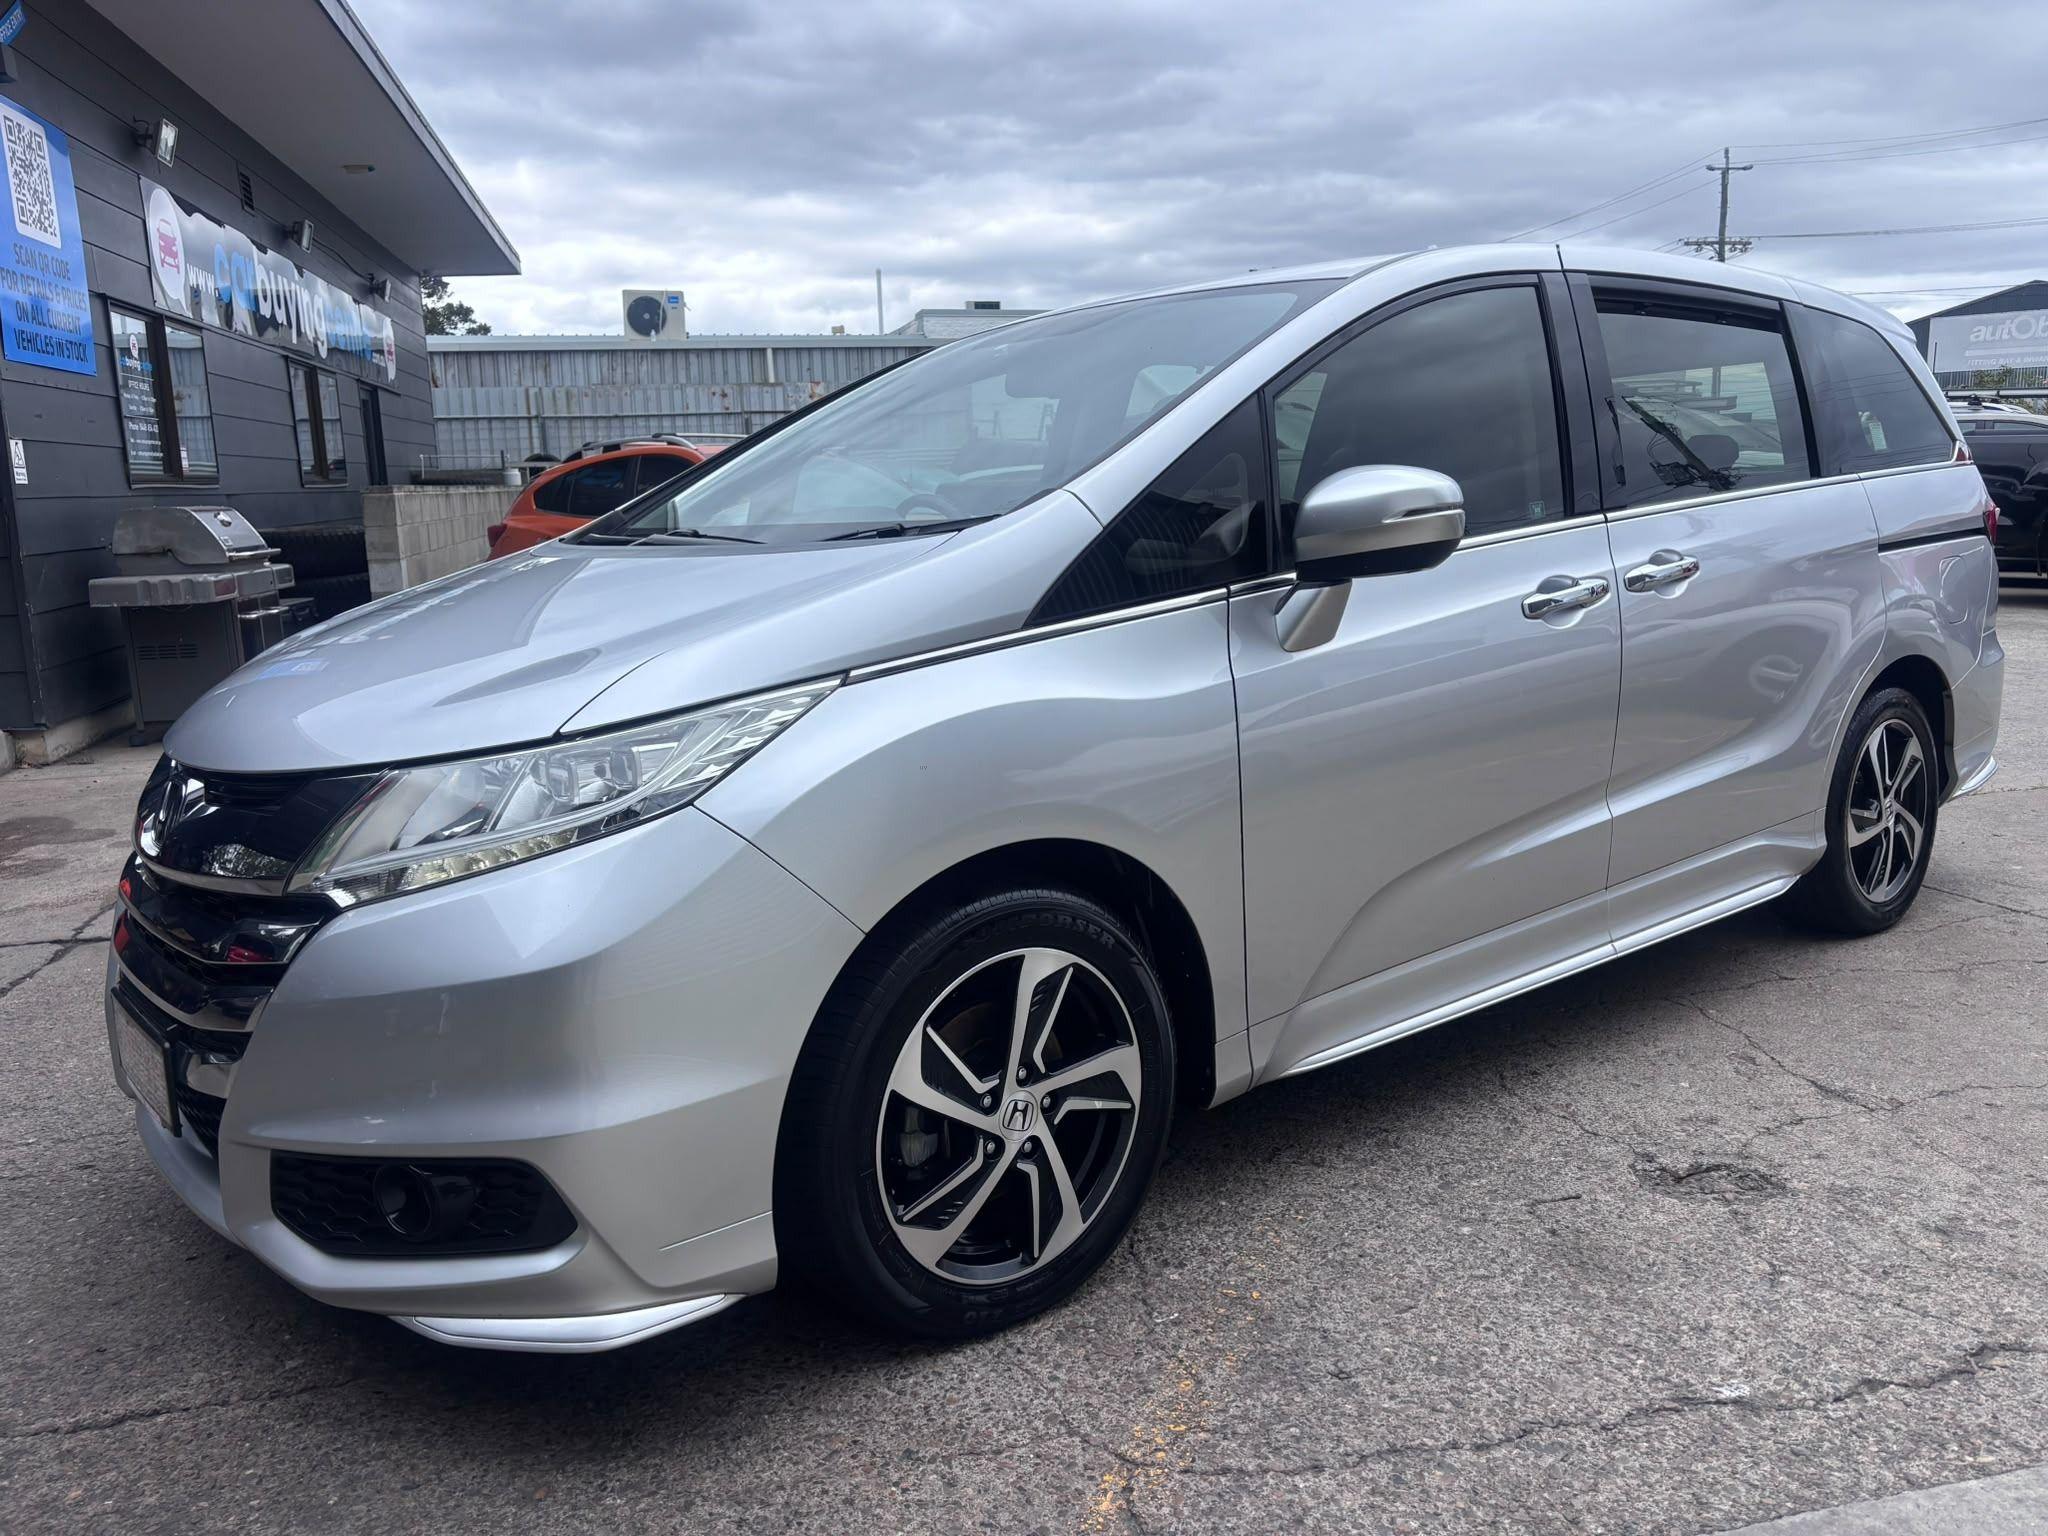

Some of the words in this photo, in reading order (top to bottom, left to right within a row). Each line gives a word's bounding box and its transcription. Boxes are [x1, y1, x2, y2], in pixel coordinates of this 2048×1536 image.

[13, 243, 37, 270] SCAN
[39, 252, 49, 277] QR
[51, 256, 71, 280] CODE
[0, 267, 18, 292] FOR
[20, 273, 54, 302] DETAILS
[62, 287, 87, 313] PRICES
[15, 300, 29, 323] ON
[31, 304, 46, 328] ALL
[47, 308, 82, 336] CURRENT
[14, 328, 55, 356] VEHICLES
[65, 340, 88, 364] STOCK
